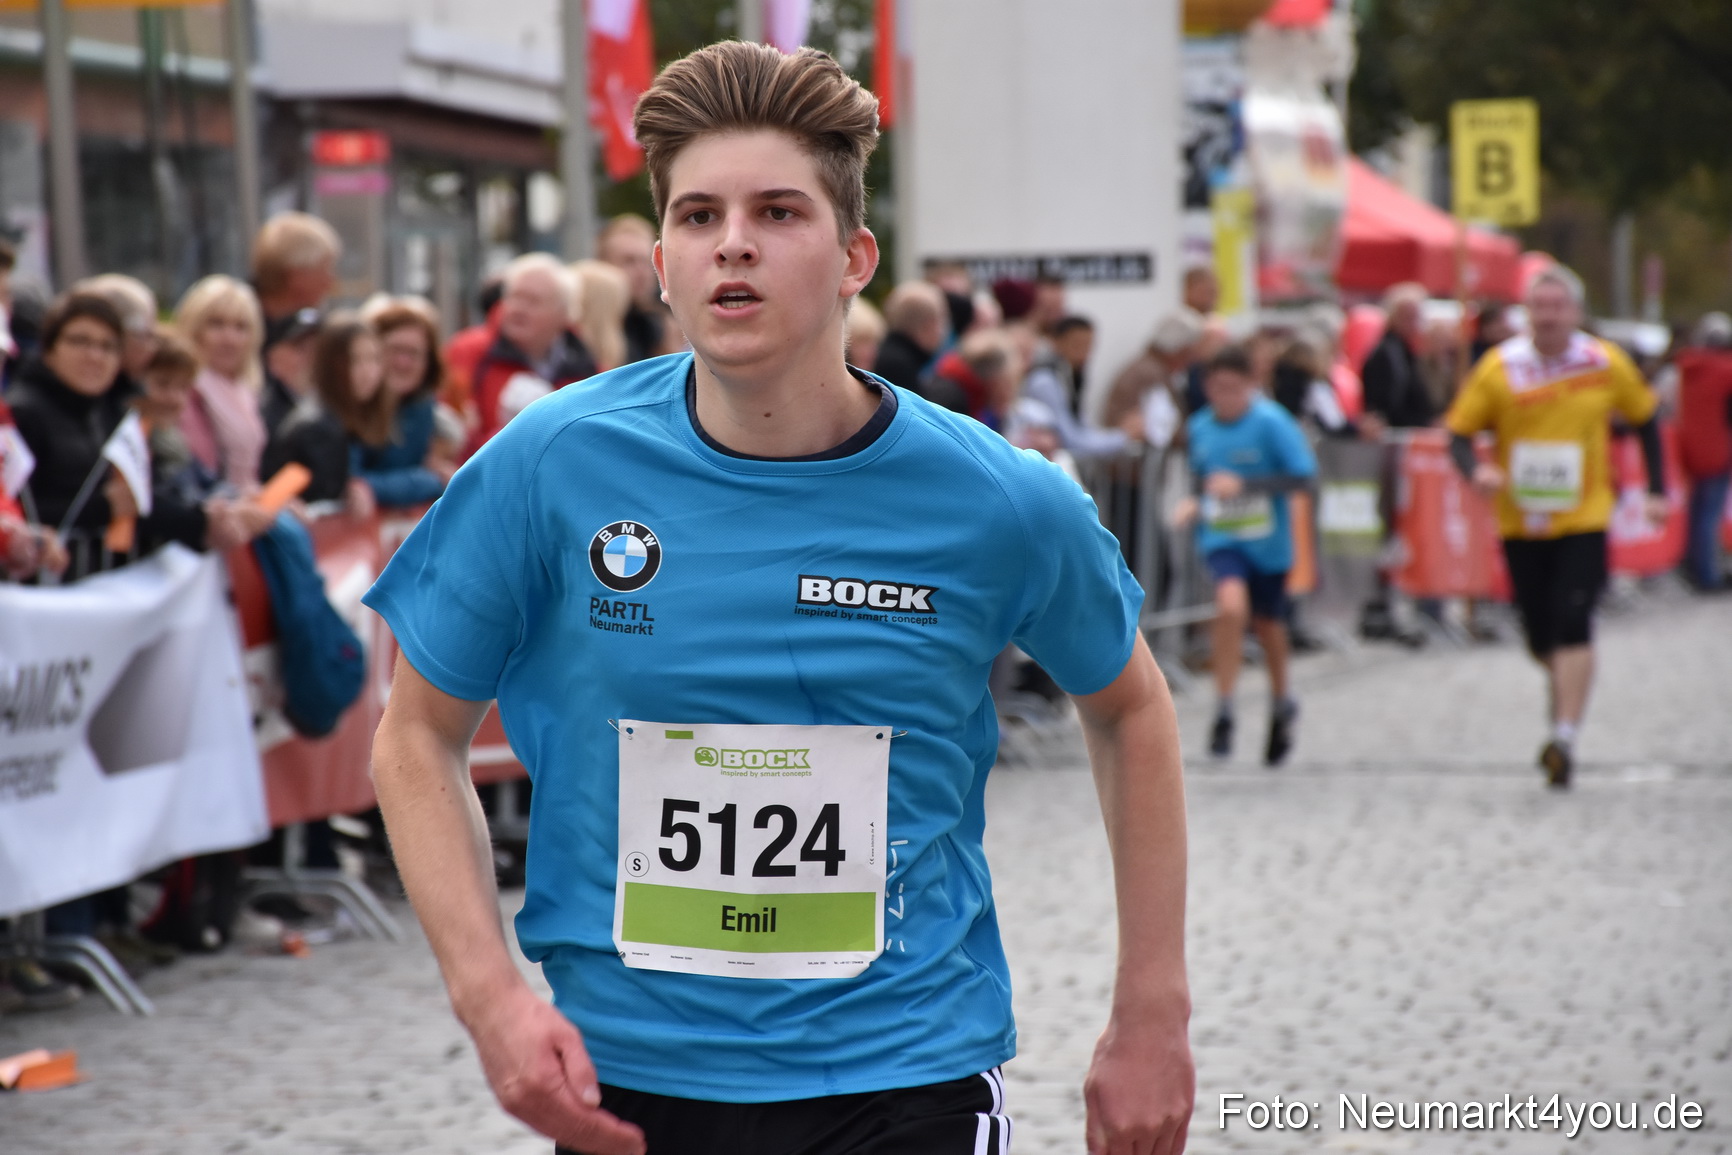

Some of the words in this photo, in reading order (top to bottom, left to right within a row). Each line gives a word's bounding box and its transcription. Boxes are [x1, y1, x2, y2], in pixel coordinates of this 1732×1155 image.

[1477, 140, 1516, 196] B
[598, 523, 656, 548] BMW
[800, 578, 931, 611] BOCK
[590, 597, 655, 621] PARTL
[794, 606, 838, 618] inspired
[840, 611, 854, 621] by
[856, 612, 888, 623] smart
[891, 615, 938, 625] concepts
[589, 615, 654, 635] Neumarkt
[721, 749, 810, 768] BOCK
[720, 769, 748, 777] inspired
[658, 797, 846, 877] 5124
[633, 859, 641, 872] S
[721, 904, 777, 933] Emil
